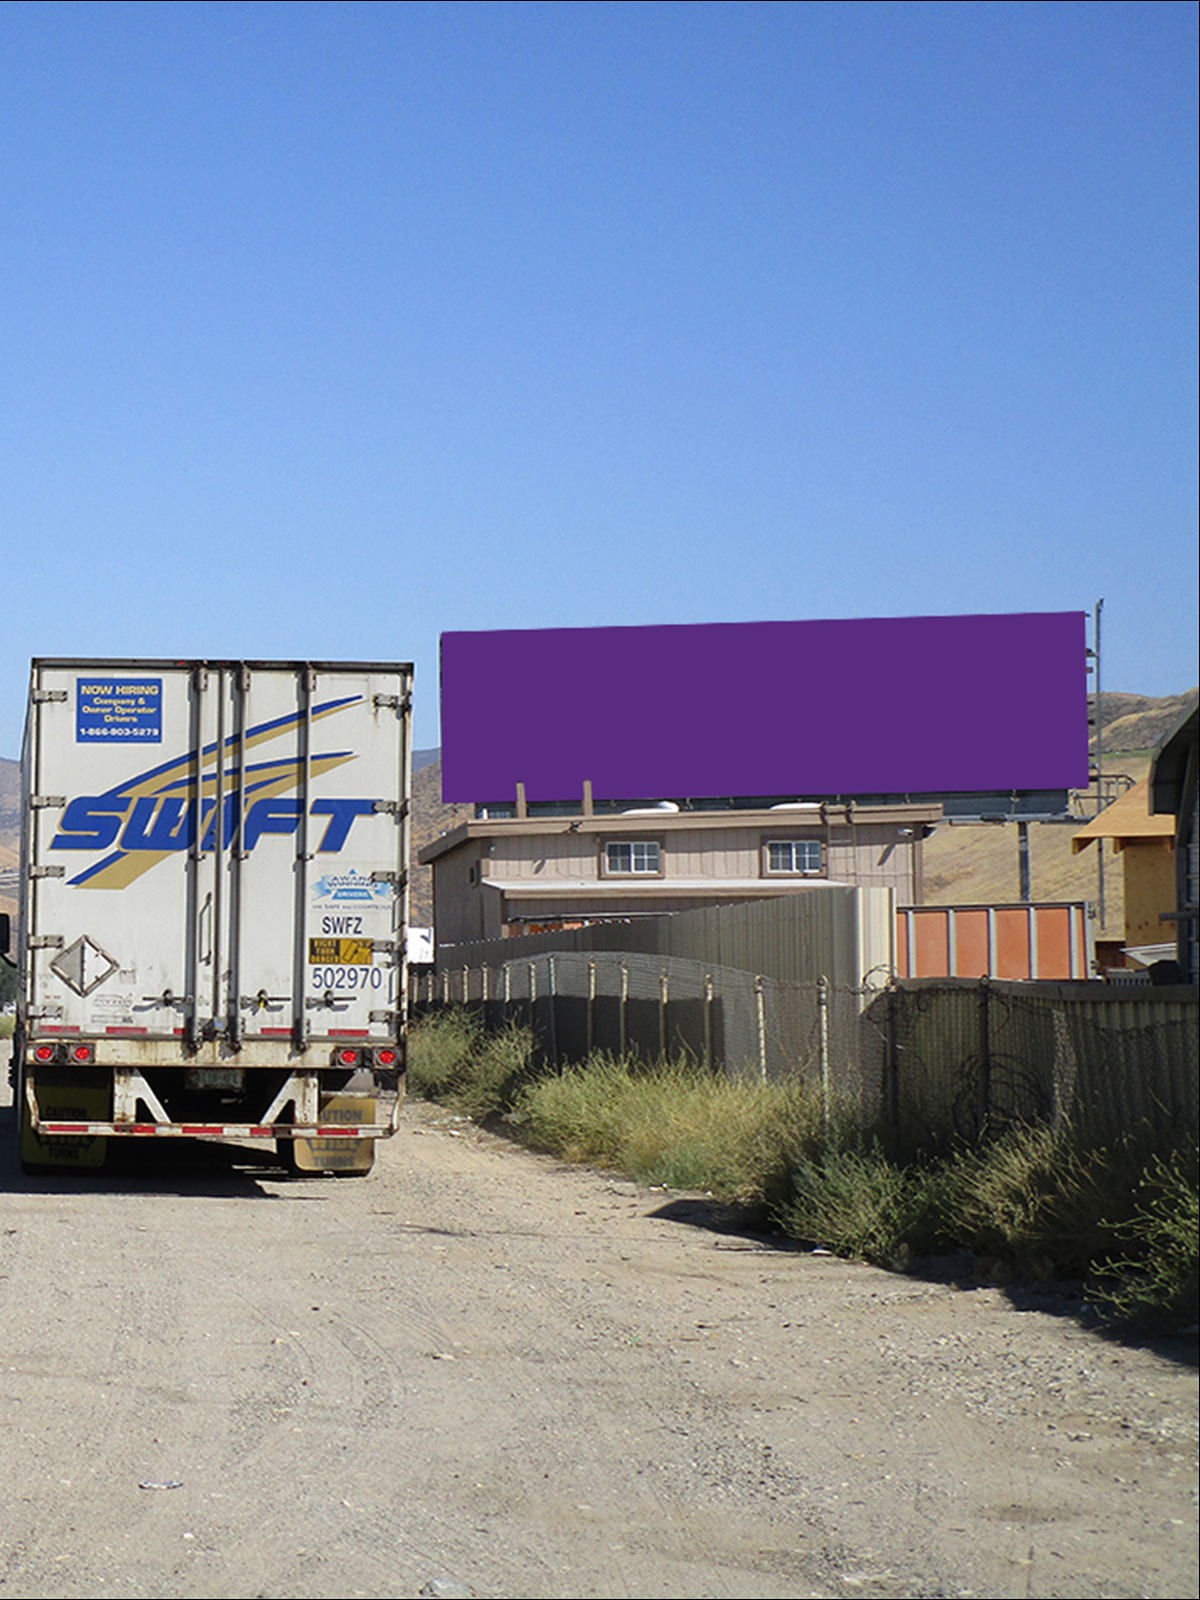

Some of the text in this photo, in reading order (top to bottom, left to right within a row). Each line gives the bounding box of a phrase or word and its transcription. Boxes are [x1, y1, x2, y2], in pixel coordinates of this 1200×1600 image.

[81, 685, 159, 695] NOW HIRING
[93, 697, 135, 706] Company
[82, 705, 157, 715] Owner Operator
[104, 714, 138, 722] Drivers
[48, 796, 383, 853] SWIFT
[322, 916, 362, 934] SWFZ
[312, 967, 382, 989] 502970
[318, 1109, 362, 1121] UTION
[313, 1156, 355, 1167] TURNS
